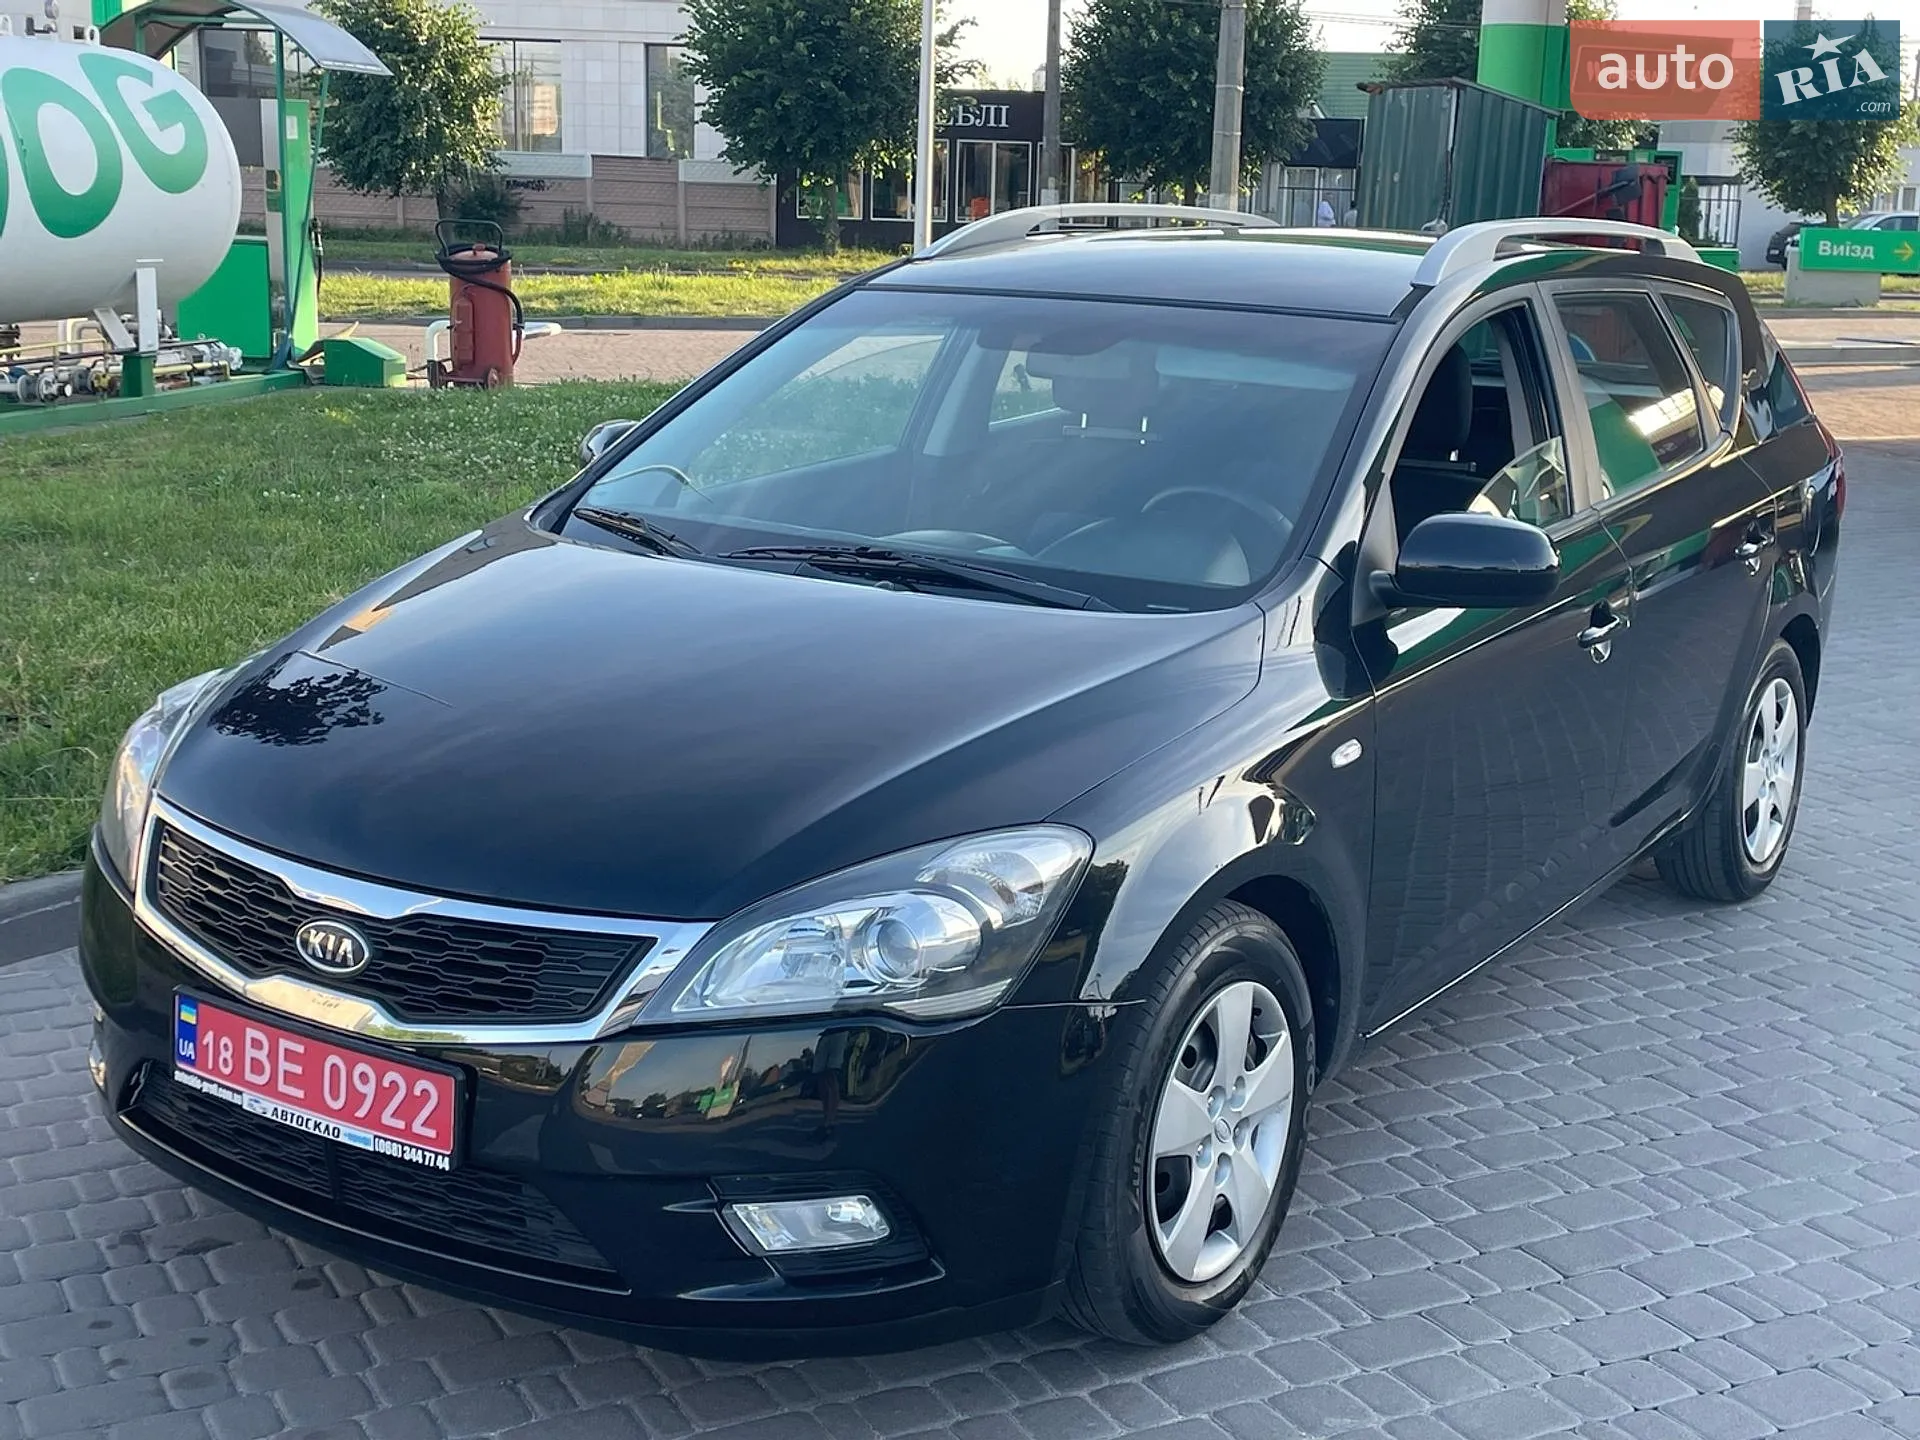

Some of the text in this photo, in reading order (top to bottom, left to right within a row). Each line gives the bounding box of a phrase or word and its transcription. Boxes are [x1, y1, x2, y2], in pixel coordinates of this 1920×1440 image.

[0, 53, 209, 239] OG
[1818, 240, 1875, 260] Виїзд
[307, 929, 354, 966] KIA
[179, 1038, 196, 1060] UA
[202, 1030, 234, 1076] 18
[244, 1027, 306, 1099] BE
[323, 1055, 438, 1138] 0922
[271, 1106, 341, 1139] АВТОСКЛО
